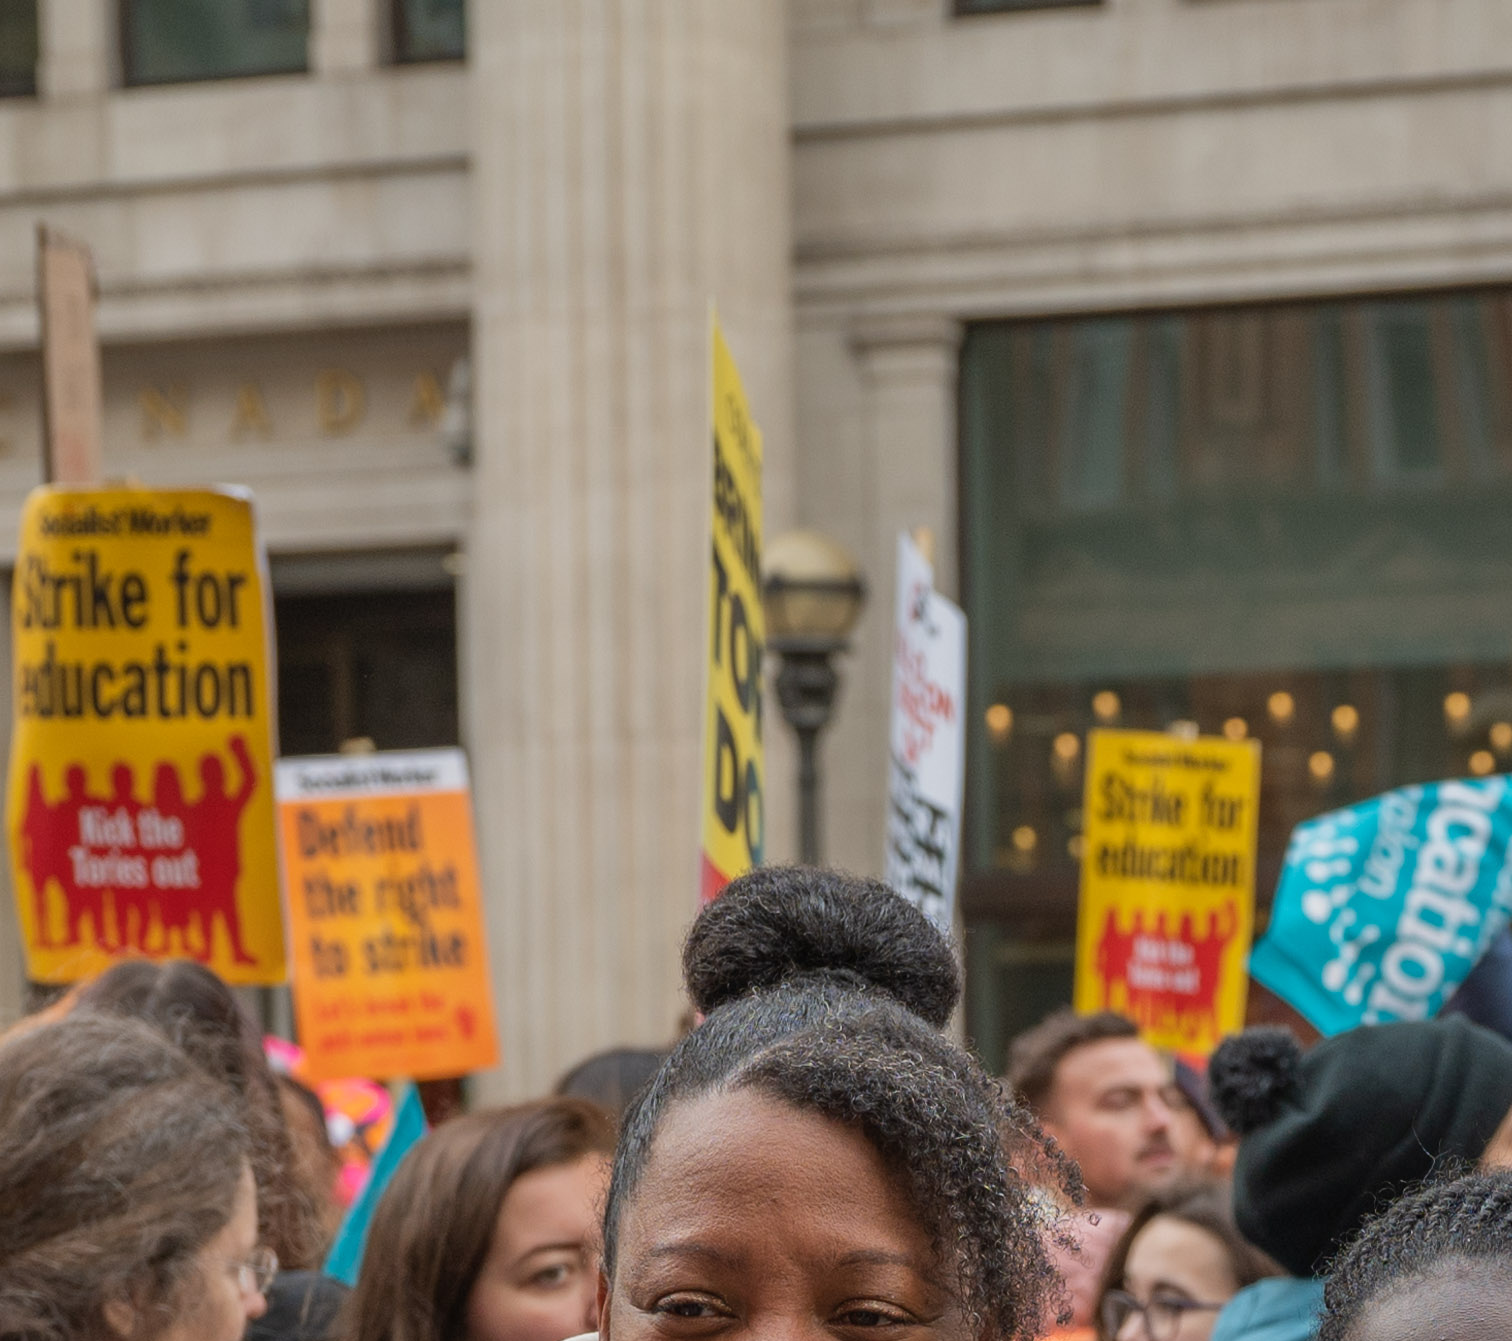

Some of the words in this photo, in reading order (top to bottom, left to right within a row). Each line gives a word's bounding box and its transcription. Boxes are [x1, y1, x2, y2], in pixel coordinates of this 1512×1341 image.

[172, 549, 246, 629] for
[79, 806, 136, 848] Kick
[138, 807, 185, 849] the
[296, 803, 422, 860] Defend
[68, 845, 149, 889] Tories
[151, 847, 202, 889] out
[303, 873, 361, 918] the
[373, 864, 459, 927] right
[311, 934, 350, 978] to
[363, 925, 466, 973] strike
